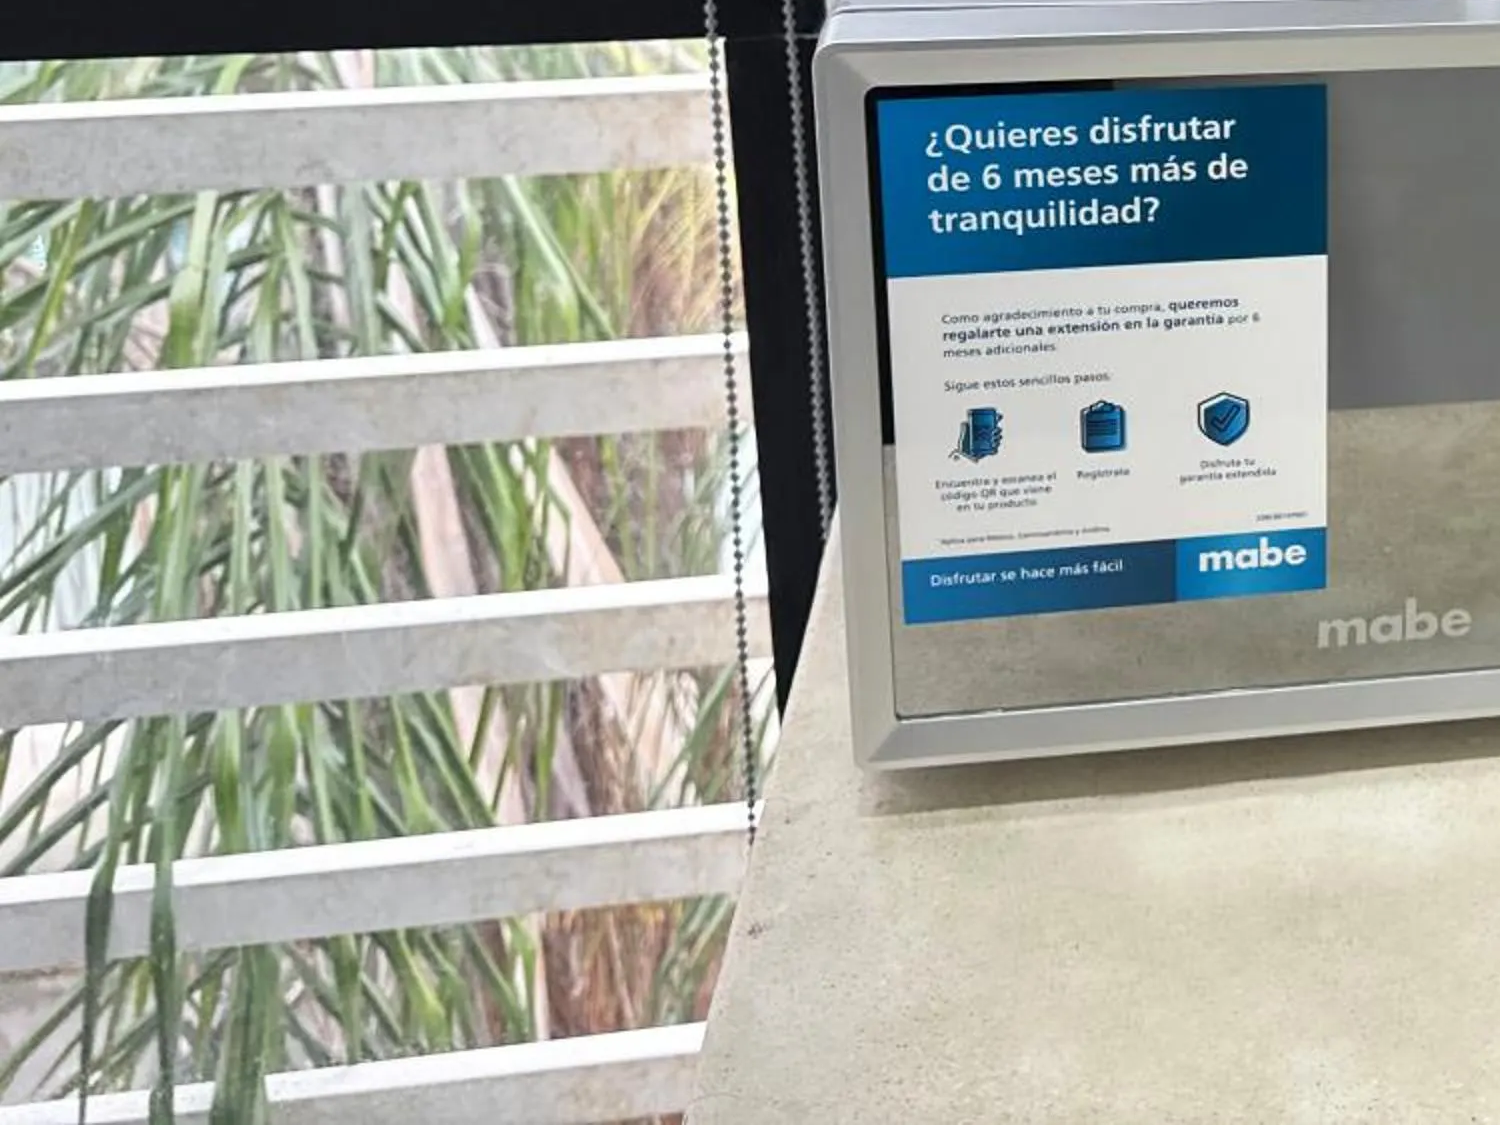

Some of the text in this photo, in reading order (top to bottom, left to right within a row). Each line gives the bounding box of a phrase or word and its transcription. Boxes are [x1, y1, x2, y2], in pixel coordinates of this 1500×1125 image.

[924, 115, 1237, 158] ¿Quieres disfrutar
[927, 153, 1249, 193] de 6 meses más de
[928, 196, 1161, 236] tranquilidad?
[941, 297, 1239, 325] Como agradecimiento a tu compra, queremos
[942, 325, 1012, 343] regalarte
[1015, 326, 1044, 337] una
[1047, 318, 1121, 335] extensión
[1124, 320, 1143, 331] en
[1147, 317, 1160, 329] la
[1163, 312, 1225, 330] garantía
[1228, 314, 1249, 326] por
[943, 346, 982, 359] meses
[943, 380, 979, 393] Sigue
[983, 378, 1015, 390] estos
[1018, 372, 1071, 388] sencillos
[1198, 537, 1308, 573] mabe
[931, 558, 1124, 587] Disfrutar se hace más fácil
[1317, 596, 1473, 648] mabe
